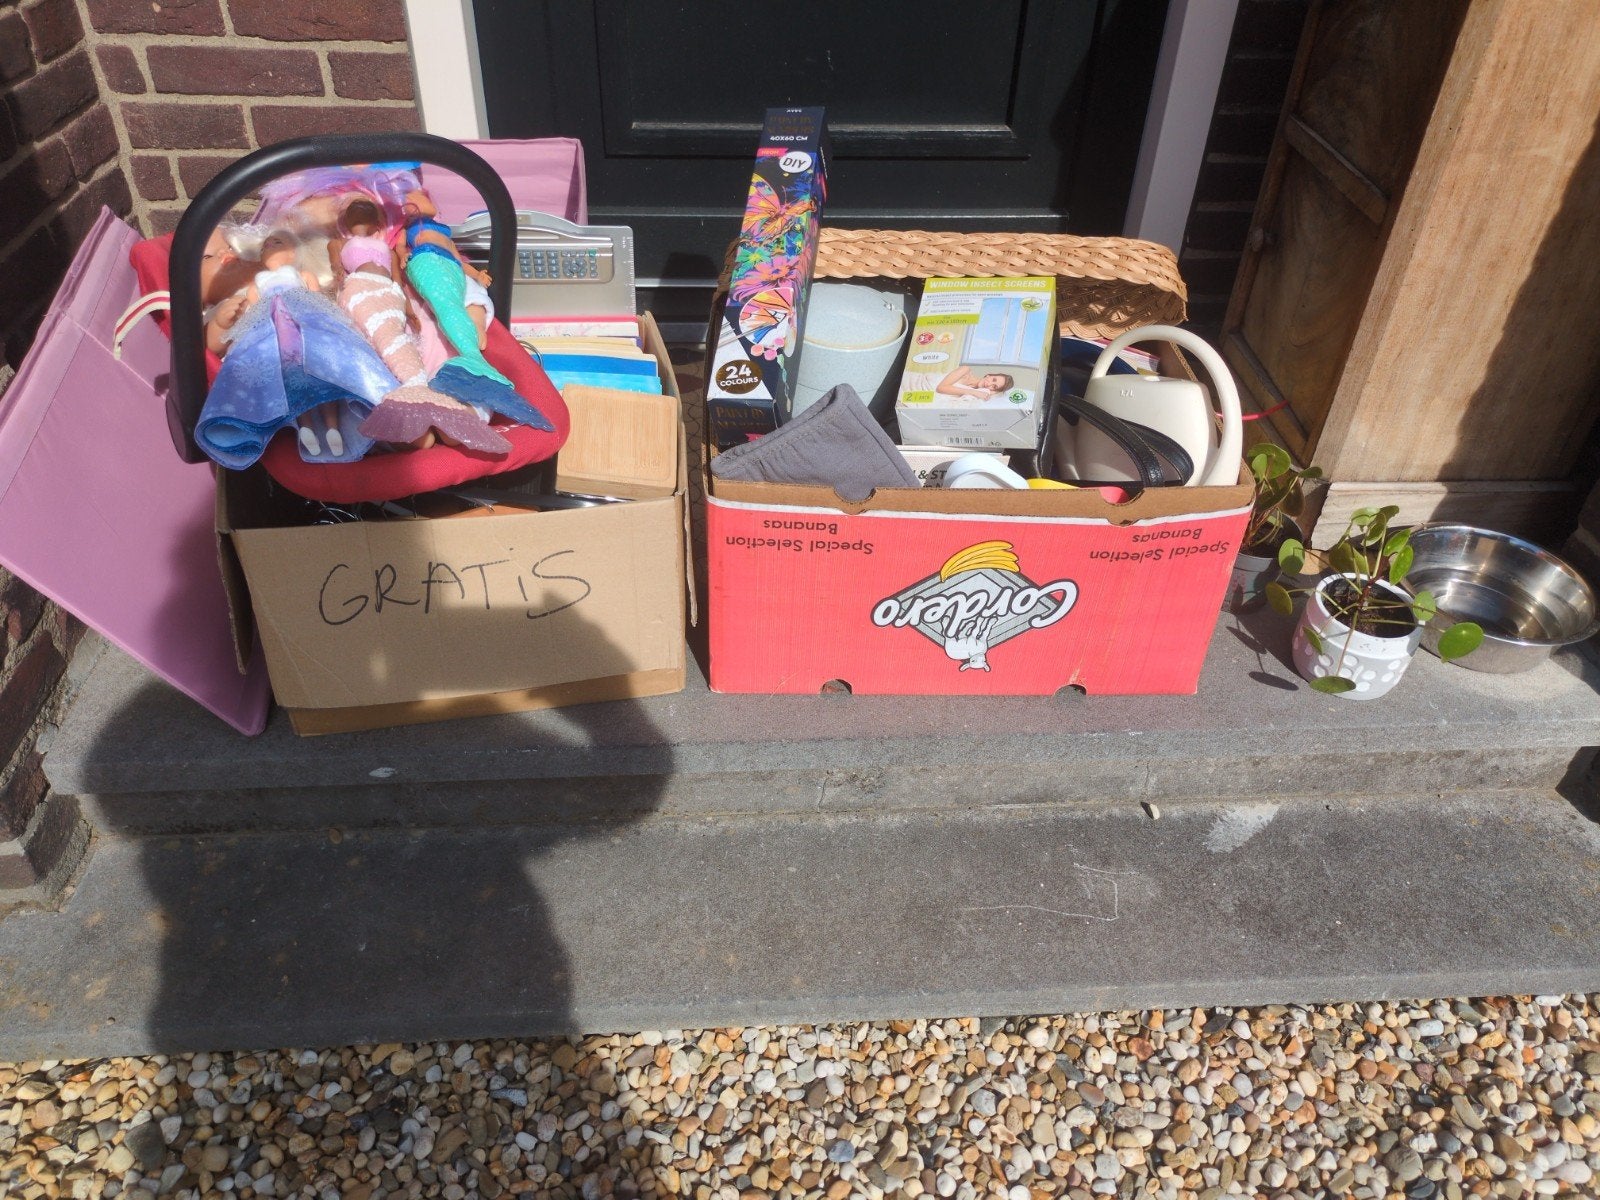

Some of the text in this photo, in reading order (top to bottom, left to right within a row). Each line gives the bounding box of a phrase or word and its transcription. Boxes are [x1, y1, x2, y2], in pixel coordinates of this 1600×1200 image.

[782, 157, 806, 169] DIY
[930, 280, 1046, 289] WINDOW INSECT SCREENS
[725, 364, 752, 379] 24
[720, 376, 759, 387] COLOURS
[917, 469, 929, 480] &
[763, 519, 838, 535] Bananas
[1132, 527, 1202, 543] Bananas
[725, 536, 874, 555] Special Selection
[1089, 540, 1230, 563] Special Selection
[870, 578, 1080, 638] Cordero
